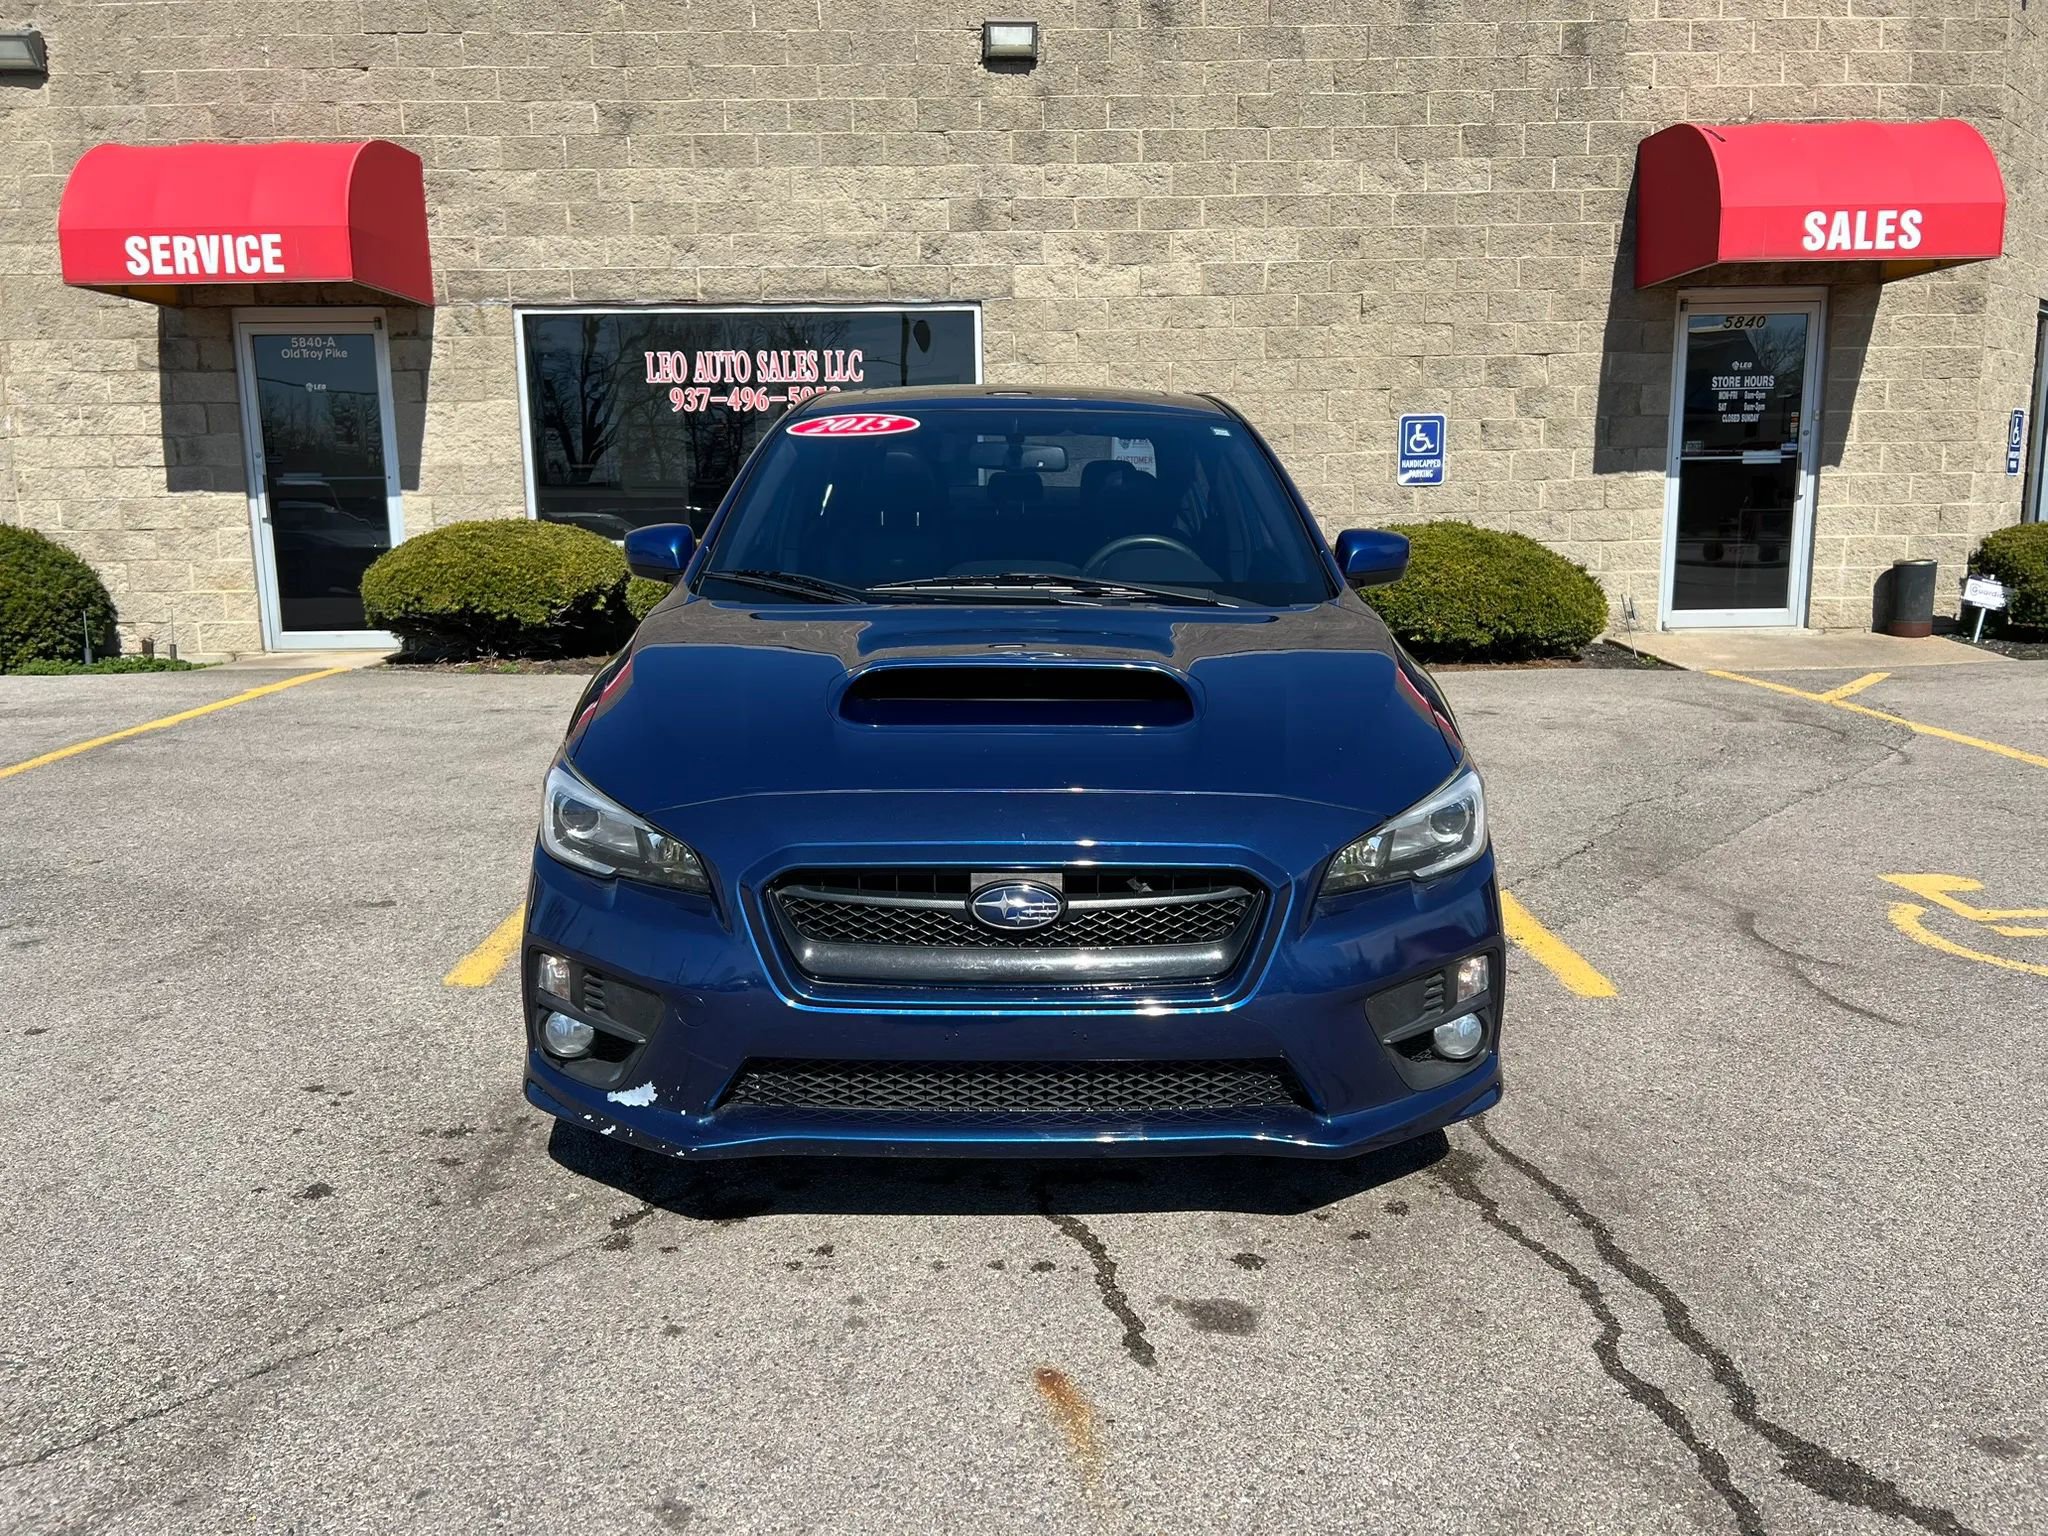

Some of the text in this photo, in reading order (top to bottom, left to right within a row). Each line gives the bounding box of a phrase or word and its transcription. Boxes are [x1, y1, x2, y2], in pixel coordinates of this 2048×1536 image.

[1802, 209, 1923, 251] SALES
[124, 234, 285, 276] SERVICE
[1723, 315, 1767, 329] 5840
[291, 336, 336, 348] 5840-A
[281, 348, 348, 361] Old Troy Pike
[645, 350, 864, 383] LEO AUTO SALES LLC
[1711, 375, 1775, 388] STORE HOURS
[1718, 391, 1738, 400] MON-FRI
[1718, 402, 1727, 412] SAT
[1721, 413, 1760, 423] CLOSED SUNDAY
[803, 417, 900, 433] 2015
[1401, 459, 1441, 468] HANDICAPPED
